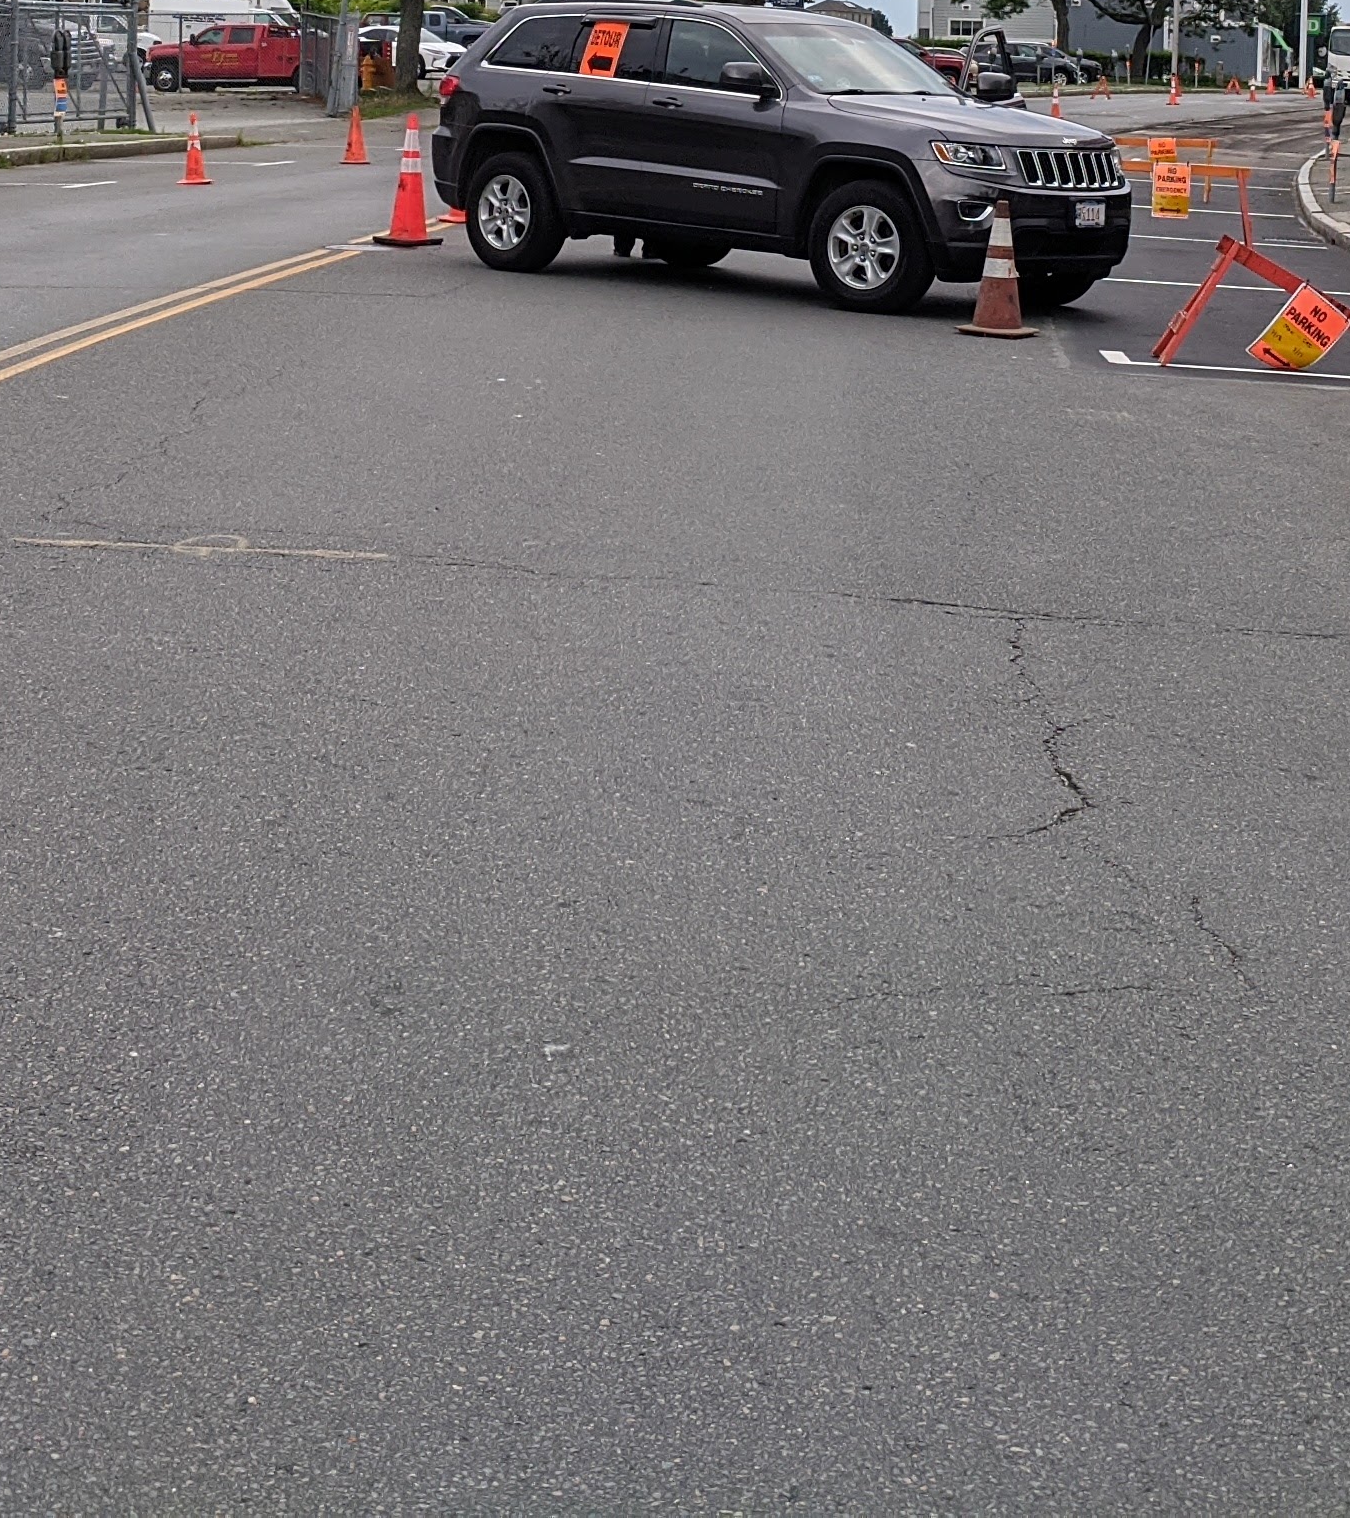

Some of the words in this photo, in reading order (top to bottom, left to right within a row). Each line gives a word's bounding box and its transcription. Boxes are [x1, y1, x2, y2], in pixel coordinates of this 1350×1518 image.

[591, 29, 622, 48] DETOUR
[1157, 175, 1187, 183] PARKING
[1309, 305, 1328, 323] NO
[1285, 306, 1331, 348] PARKING
